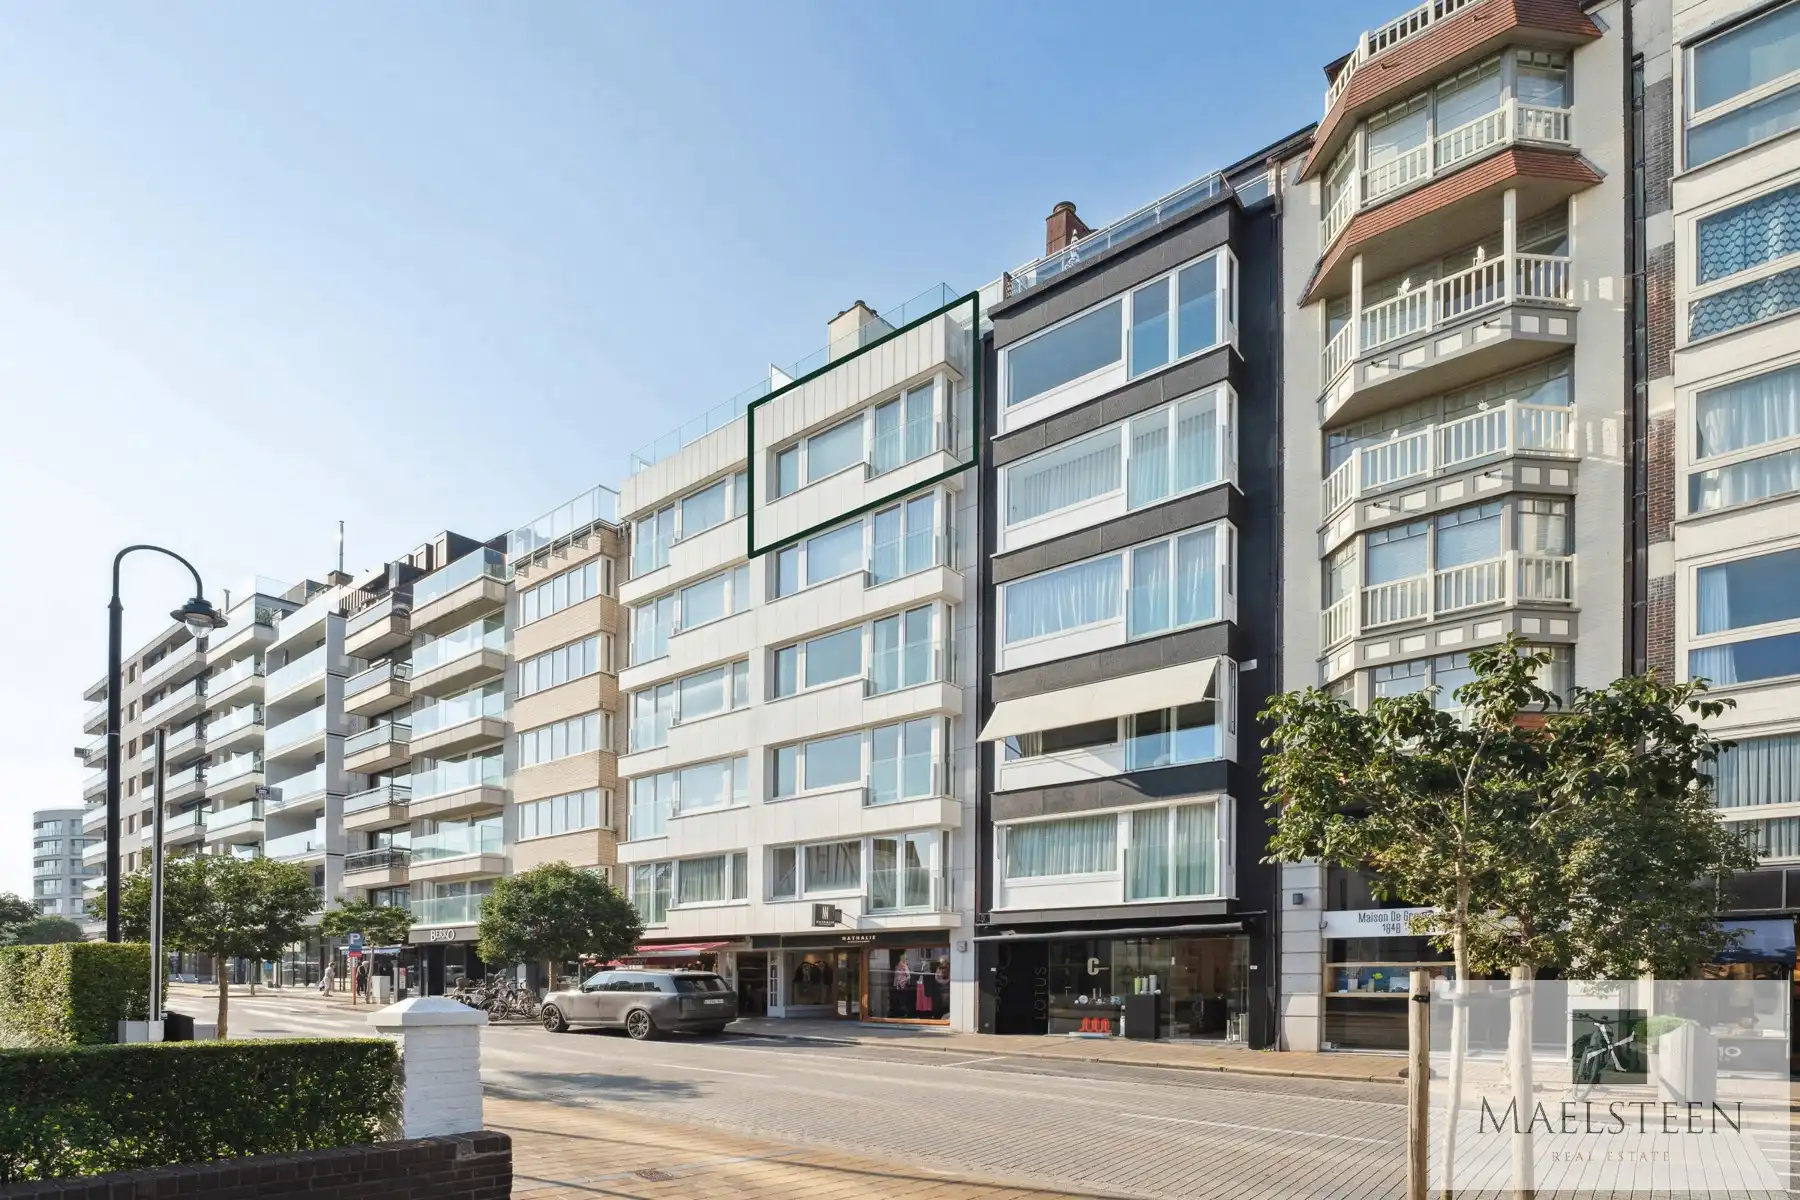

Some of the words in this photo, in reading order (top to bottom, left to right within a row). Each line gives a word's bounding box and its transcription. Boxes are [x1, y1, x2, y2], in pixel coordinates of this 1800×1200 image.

[1358, 912, 1388, 923] Maison
[1391, 911, 1401, 921] De
[1382, 923, 1400, 934] 1848
[350, 933, 361, 945] P
[1034, 966, 1047, 1020] LOTUS
